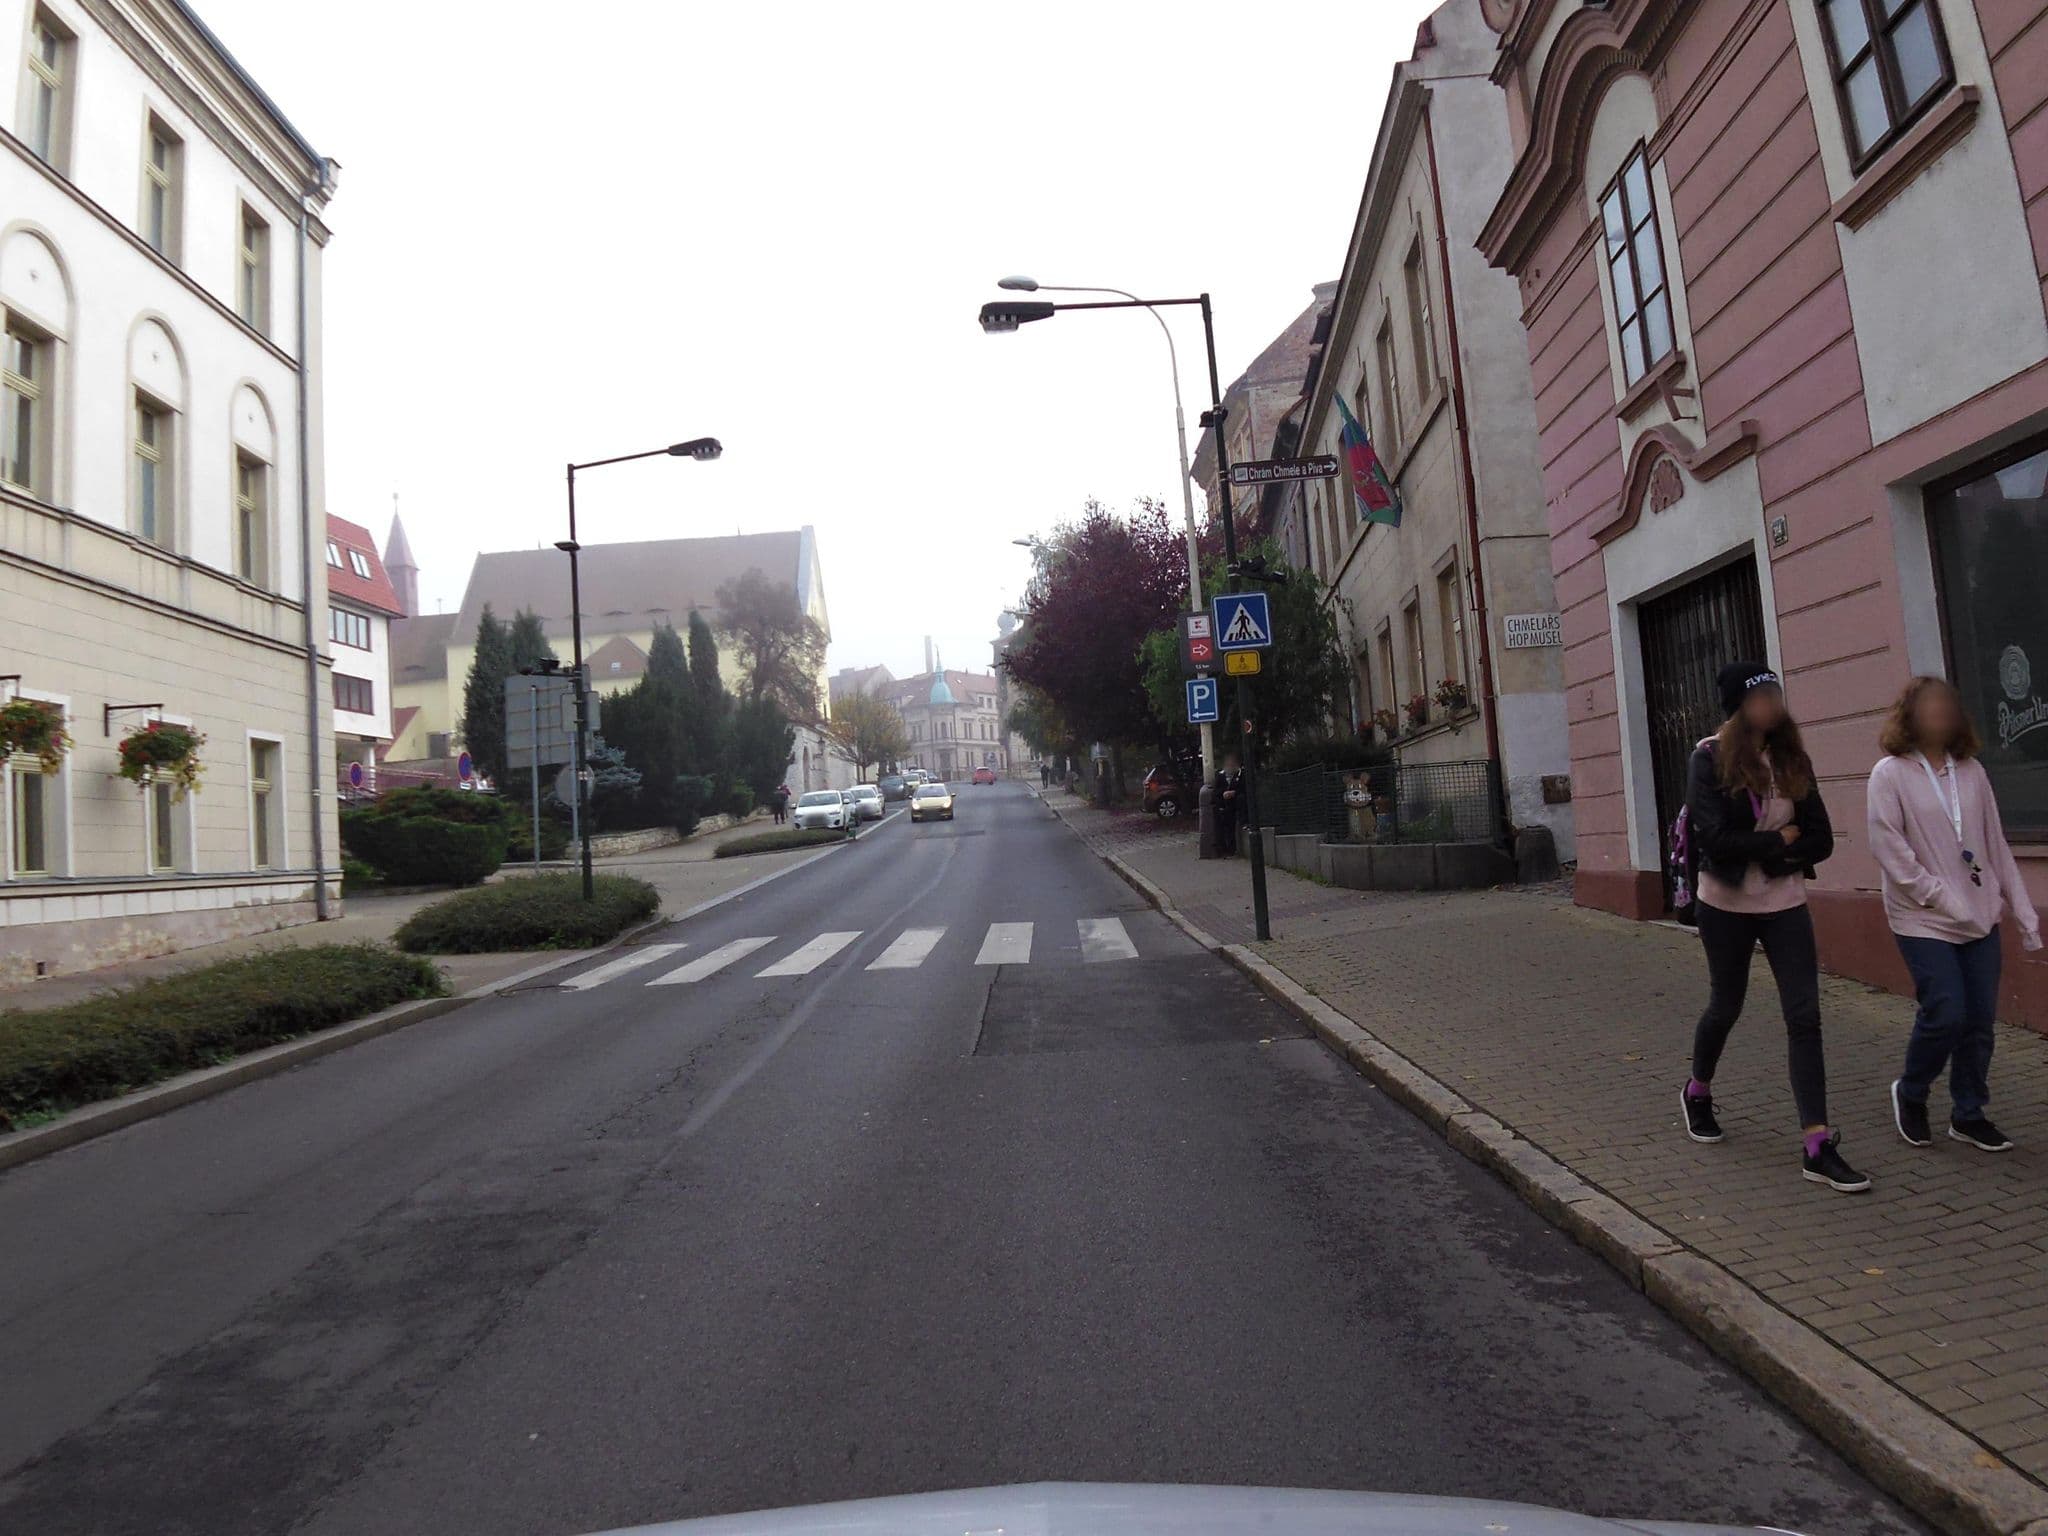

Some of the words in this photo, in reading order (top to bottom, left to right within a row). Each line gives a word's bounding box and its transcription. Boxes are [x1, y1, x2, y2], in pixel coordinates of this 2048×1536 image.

[1301, 465, 1307, 475] a
[1308, 462, 1323, 474] Piva
[1193, 685, 1210, 709] P
